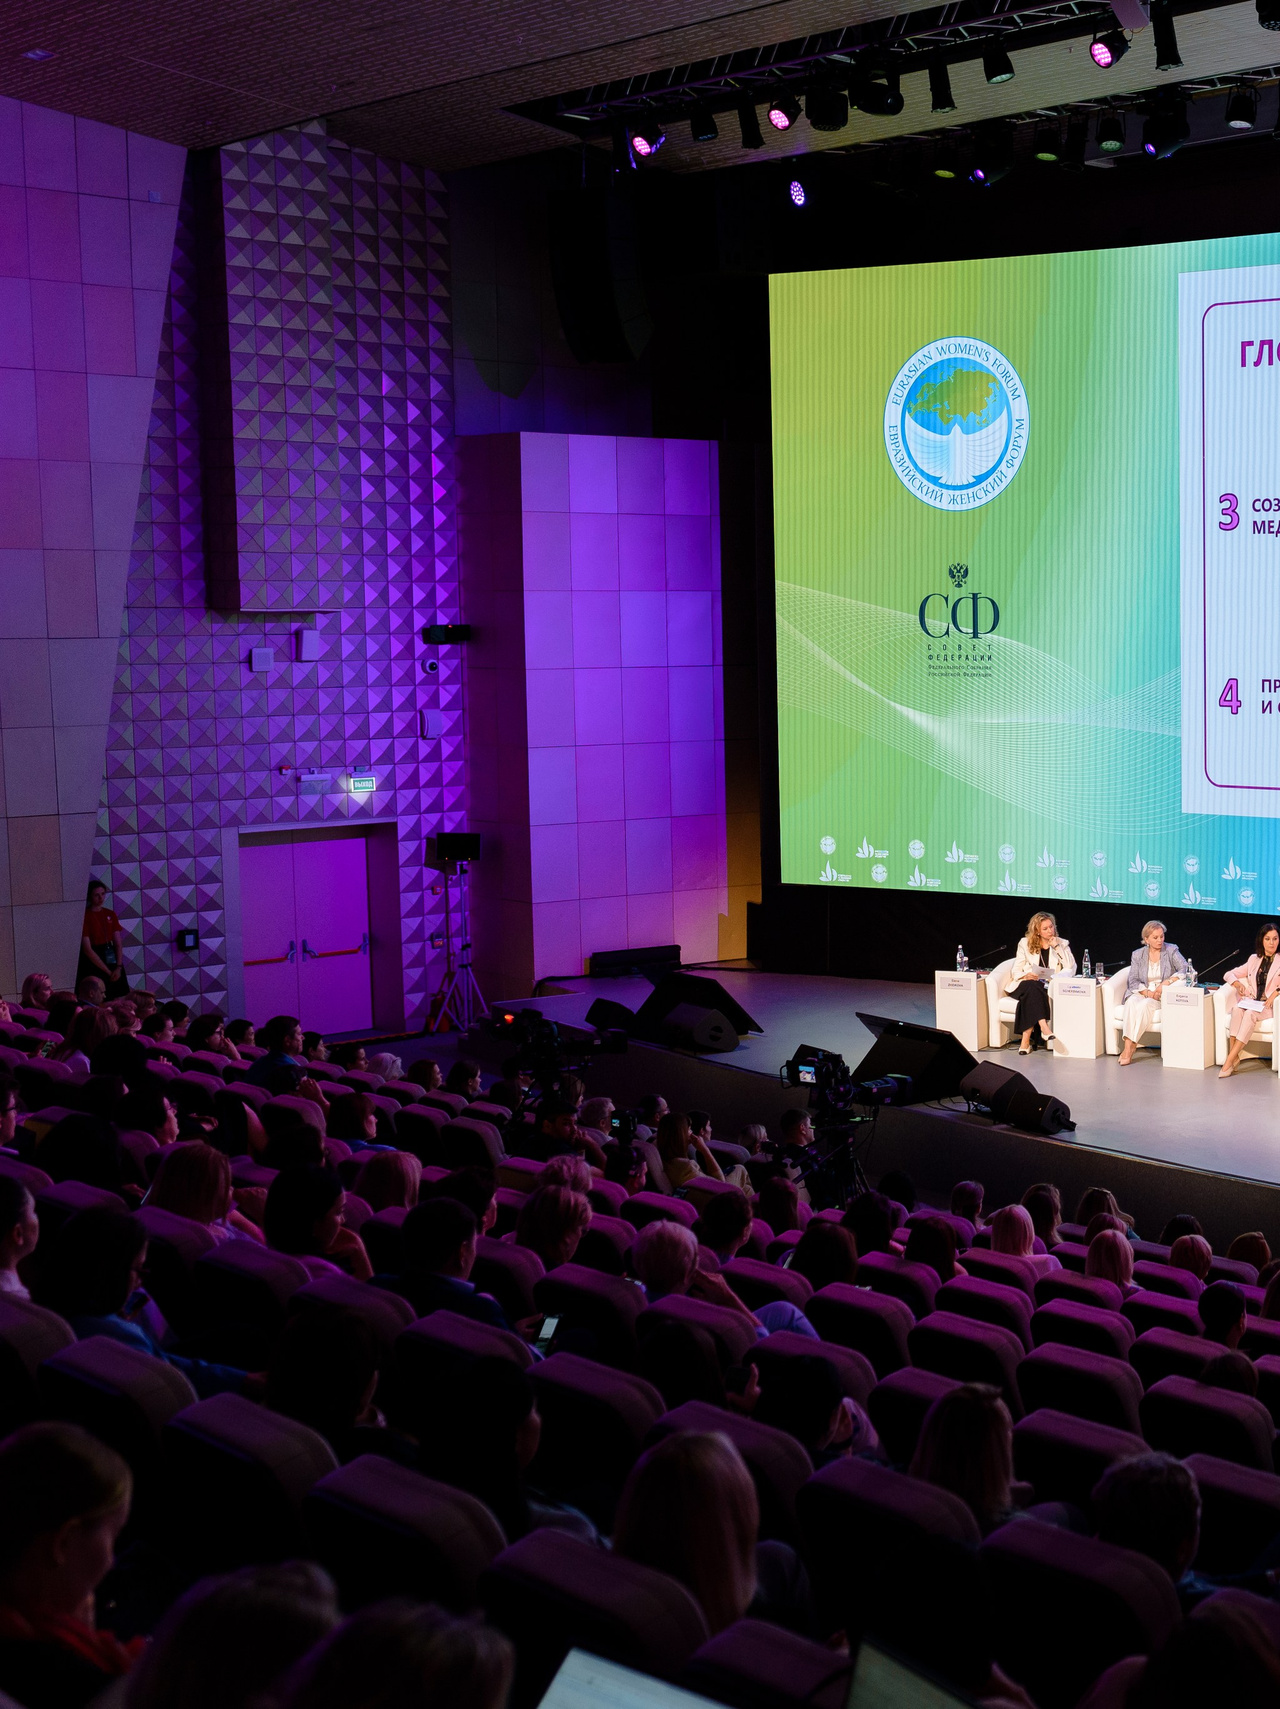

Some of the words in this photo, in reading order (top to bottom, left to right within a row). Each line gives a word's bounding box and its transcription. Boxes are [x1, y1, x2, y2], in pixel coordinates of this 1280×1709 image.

[891, 350, 933, 406] EURASIAN
[936, 342, 991, 362] WOMEN'S
[990, 358, 1022, 402] FORUM
[888, 424, 945, 503] ЕВРАЗИЙСКИЙ
[947, 470, 1008, 506] ЖЕНСКИЙ
[1005, 418, 1025, 471] ФОРУМ
[1218, 492, 1241, 532] 3
[918, 592, 1000, 640] СФ
[927, 654, 992, 662] ФЕДЕРАЦИИ
[1218, 678, 1242, 715] 4
[1262, 700, 1272, 714] И
